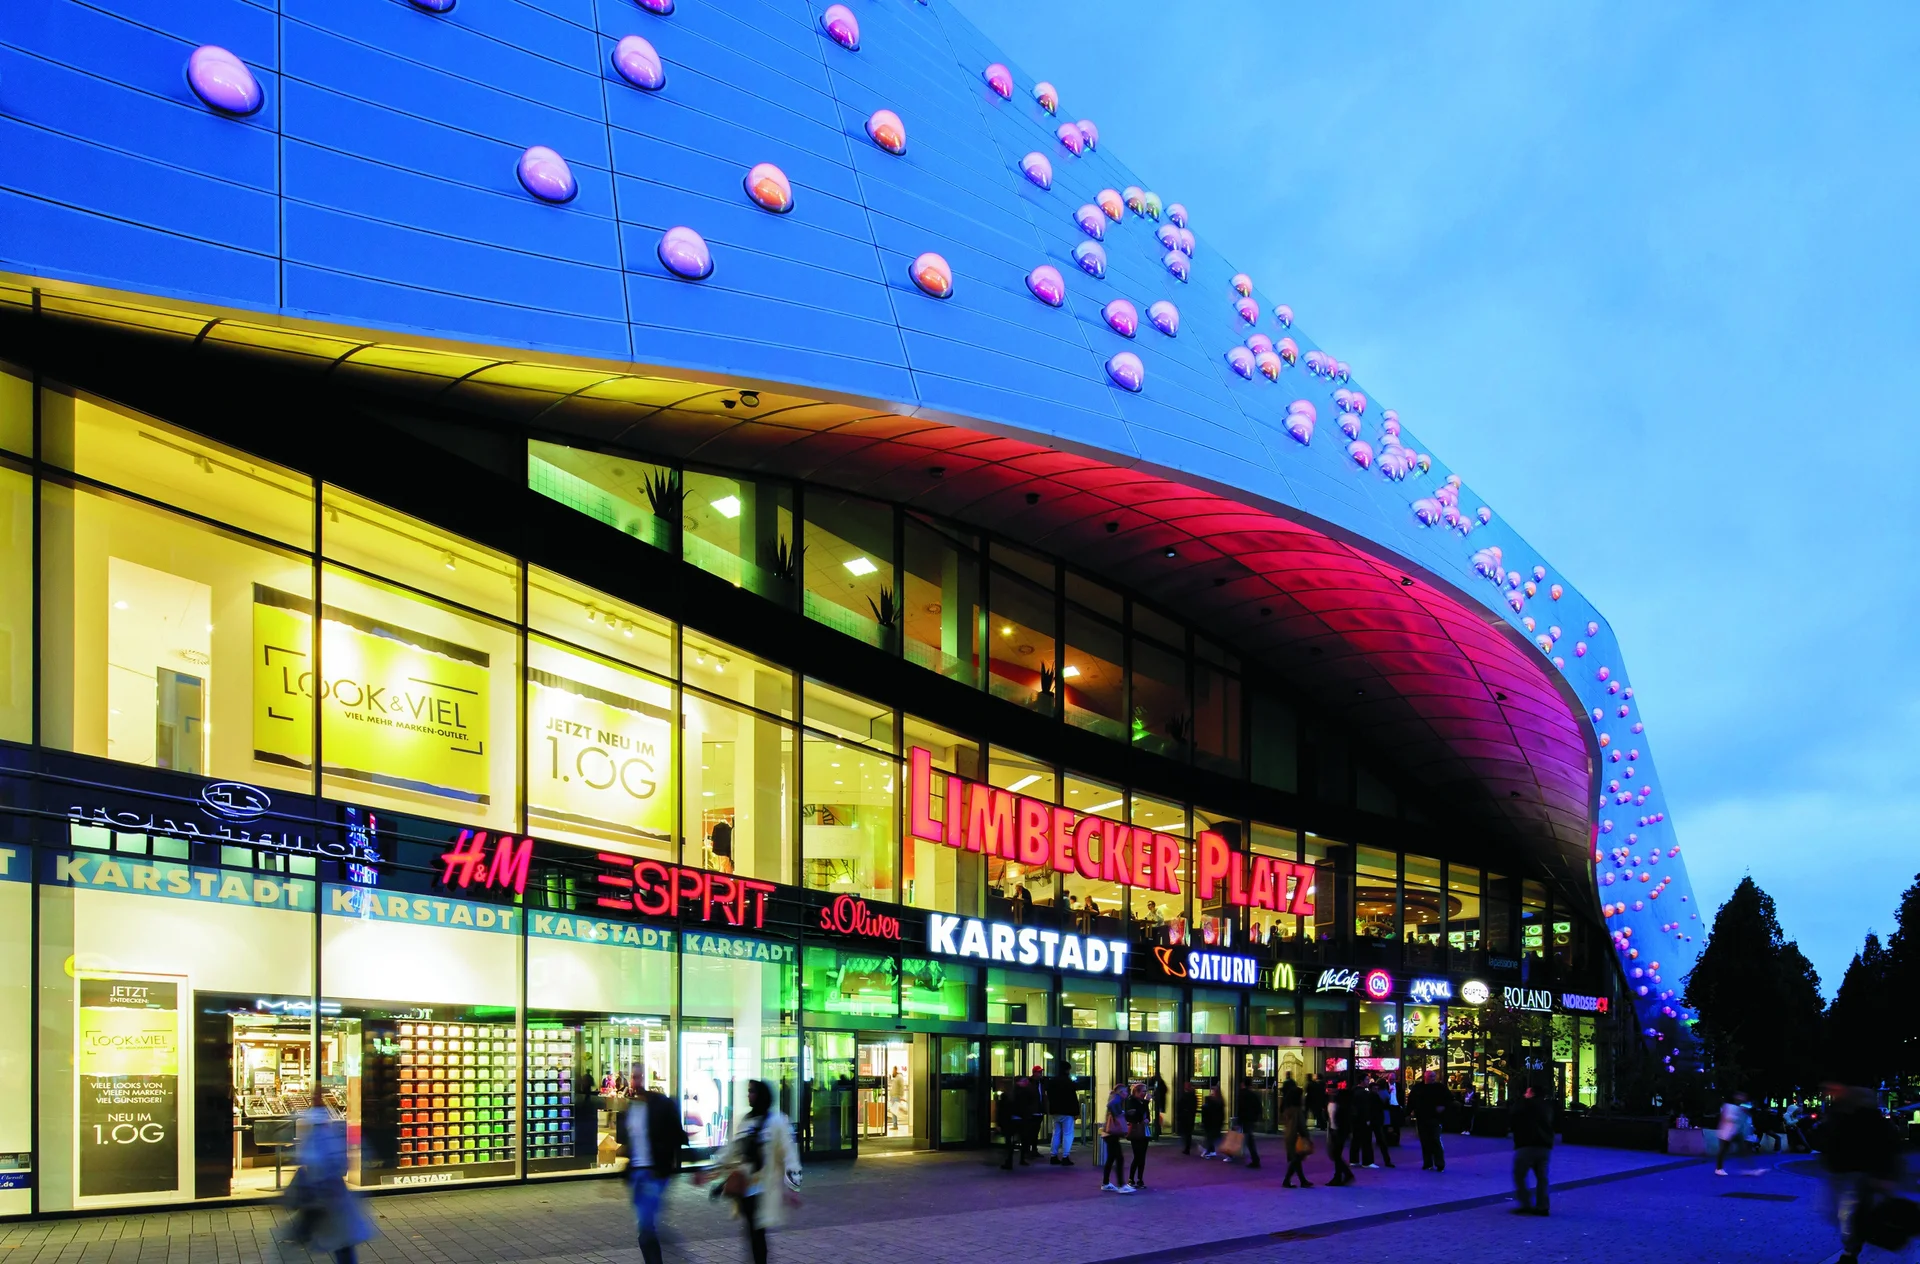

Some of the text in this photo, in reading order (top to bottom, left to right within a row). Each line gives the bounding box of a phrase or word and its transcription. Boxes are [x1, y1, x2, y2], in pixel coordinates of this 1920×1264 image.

[344, 711, 364, 722] VIEL
[366, 715, 393, 728] MEHR
[547, 717, 655, 757] JETZT NEU IM
[909, 745, 1315, 917] LIMBECKER PLATZ
[442, 829, 534, 895] H&M
[56, 855, 304, 907] KARSTADT
[598, 853, 776, 929] ESPRIT
[332, 888, 517, 931] KARSTADT
[820, 894, 902, 941] s.Oliver
[535, 914, 671, 948] KARSTADT
[686, 934, 794, 962] KARSTADT
[929, 914, 1129, 976] KARSTADT
[1189, 949, 1256, 985] SATURN
[110, 986, 148, 998] JETZT
[1504, 986, 1552, 1009] ROLAND
[1563, 994, 1597, 1011] NORDSEE
[108, 1113, 151, 1122] NEU IM
[393, 1173, 452, 1184] KARSTADT
